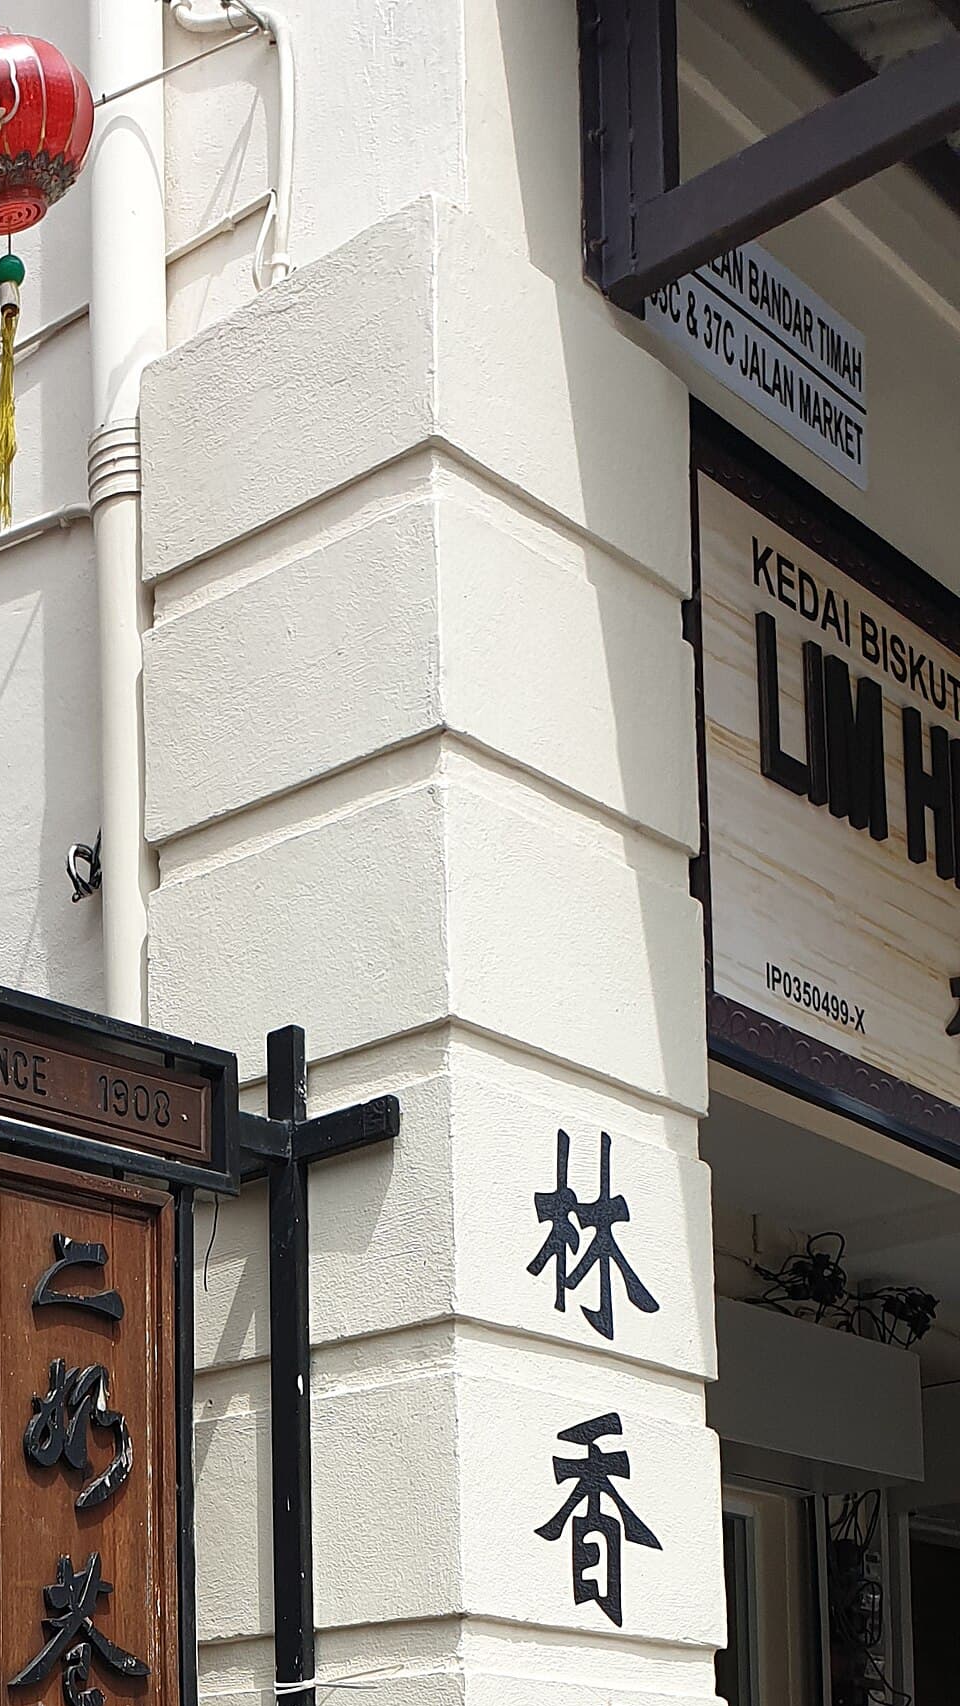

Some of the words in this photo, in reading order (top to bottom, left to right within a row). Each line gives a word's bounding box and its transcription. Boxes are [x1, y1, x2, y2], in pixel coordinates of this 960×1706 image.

[686, 290, 699, 339] &
[704, 303, 735, 366] 37C
[740, 334, 794, 413] JALAN
[799, 377, 864, 465] MARKET
[707, 249, 744, 295] LAN
[748, 259, 815, 353] BANDAR
[817, 316, 863, 393] TIMAH
[751, 536, 851, 648] KEDAI
[860, 610, 960, 722] BISKUT
[754, 610, 889, 842] LIM
[765, 961, 866, 1035] IP0350499-X
[98, 1074, 172, 1129] 1908
